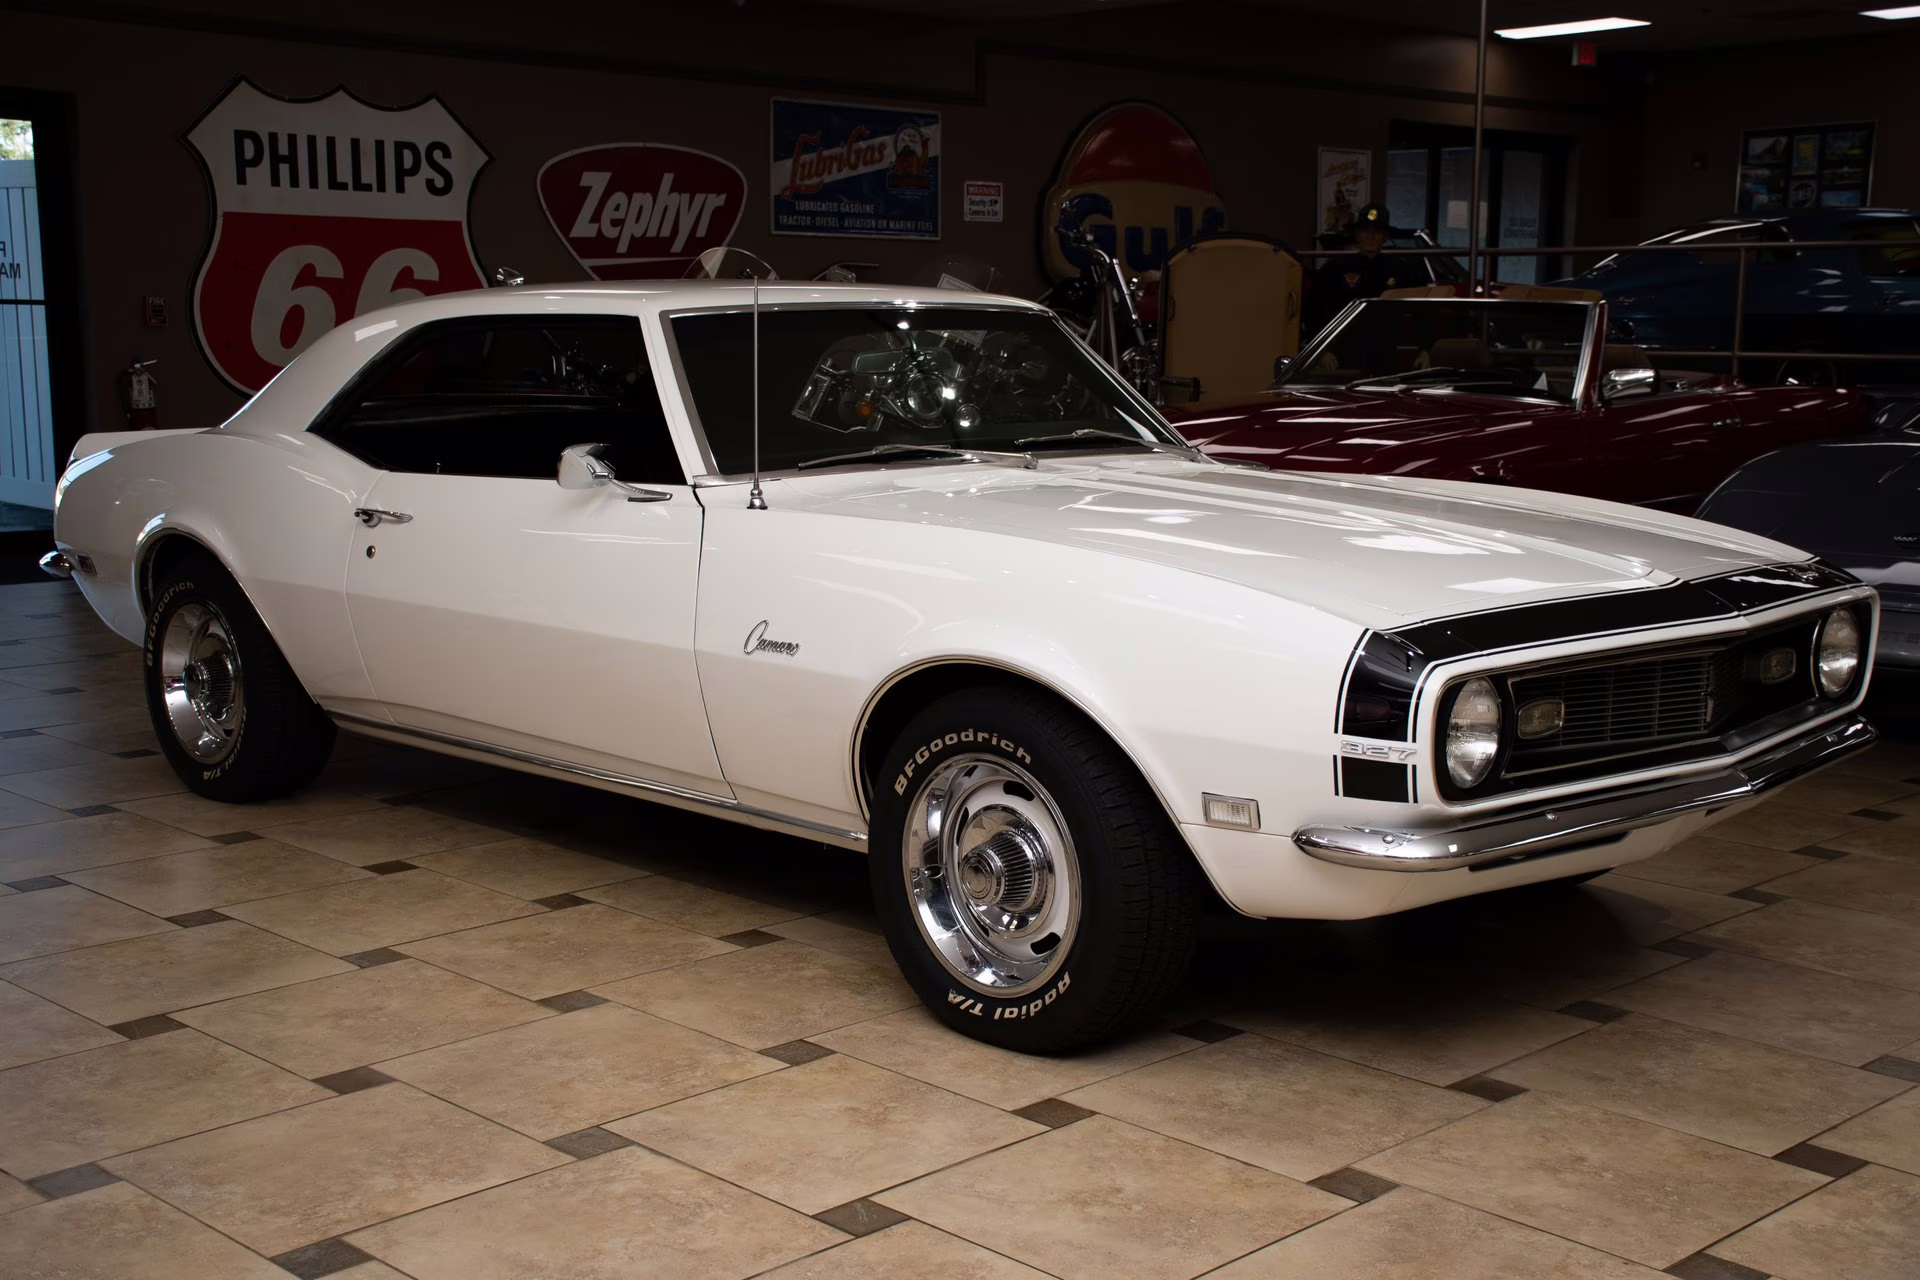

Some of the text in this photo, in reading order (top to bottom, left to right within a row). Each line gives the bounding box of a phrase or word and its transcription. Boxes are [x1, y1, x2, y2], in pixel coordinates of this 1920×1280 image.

[234, 129, 453, 197] PHILLIPS
[569, 171, 727, 254] Zephyr
[796, 200, 875, 214] LUBRICATED GASOLINE
[146, 580, 195, 669] BFGoodrich
[743, 619, 800, 657] Camaro
[893, 728, 1033, 798] BFGoodrich
[1341, 740, 1417, 761] 327
[947, 971, 1072, 1021] Radial T/A
